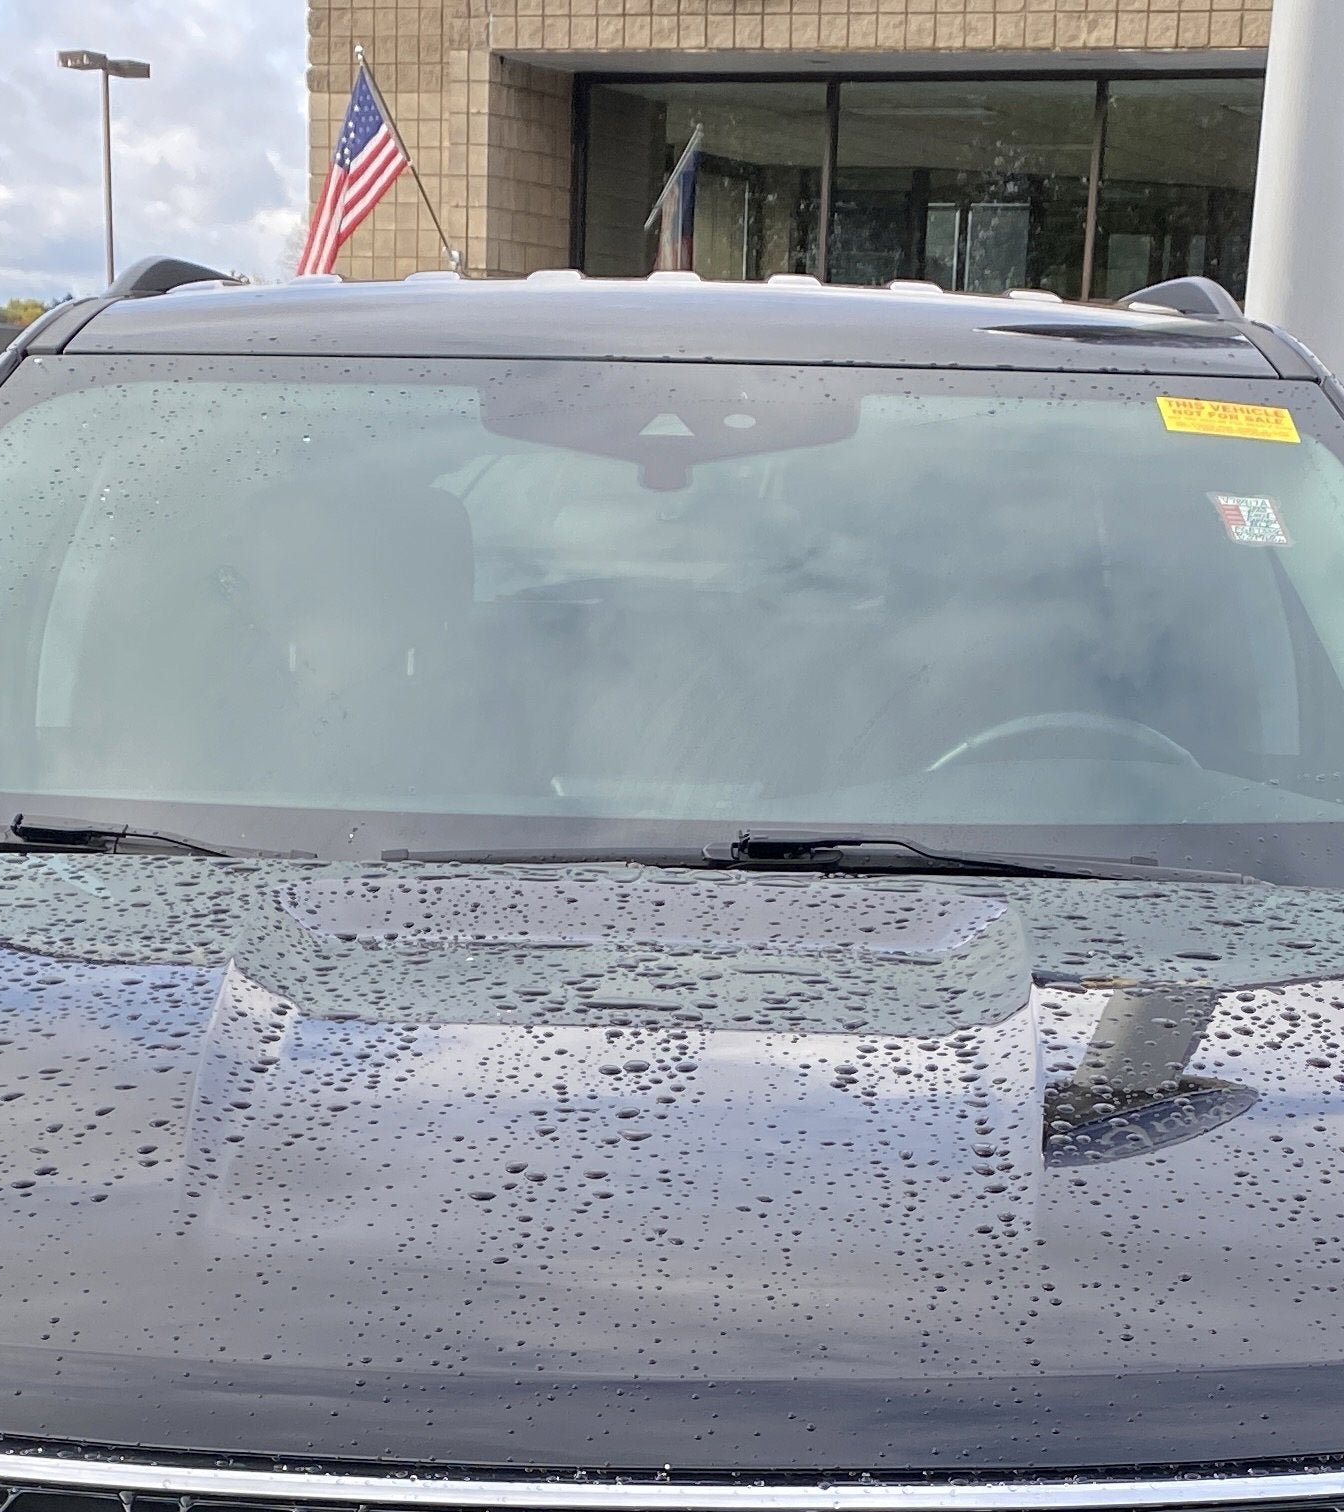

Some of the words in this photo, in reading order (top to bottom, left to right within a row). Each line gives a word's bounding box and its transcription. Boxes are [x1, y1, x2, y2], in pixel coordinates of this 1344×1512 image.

[1166, 399, 1205, 410] THIS
[1210, 401, 1285, 419] VEHICLE
[1172, 409, 1202, 417] NOT
[1208, 411, 1239, 421] FOR
[1244, 414, 1284, 425] SALE
